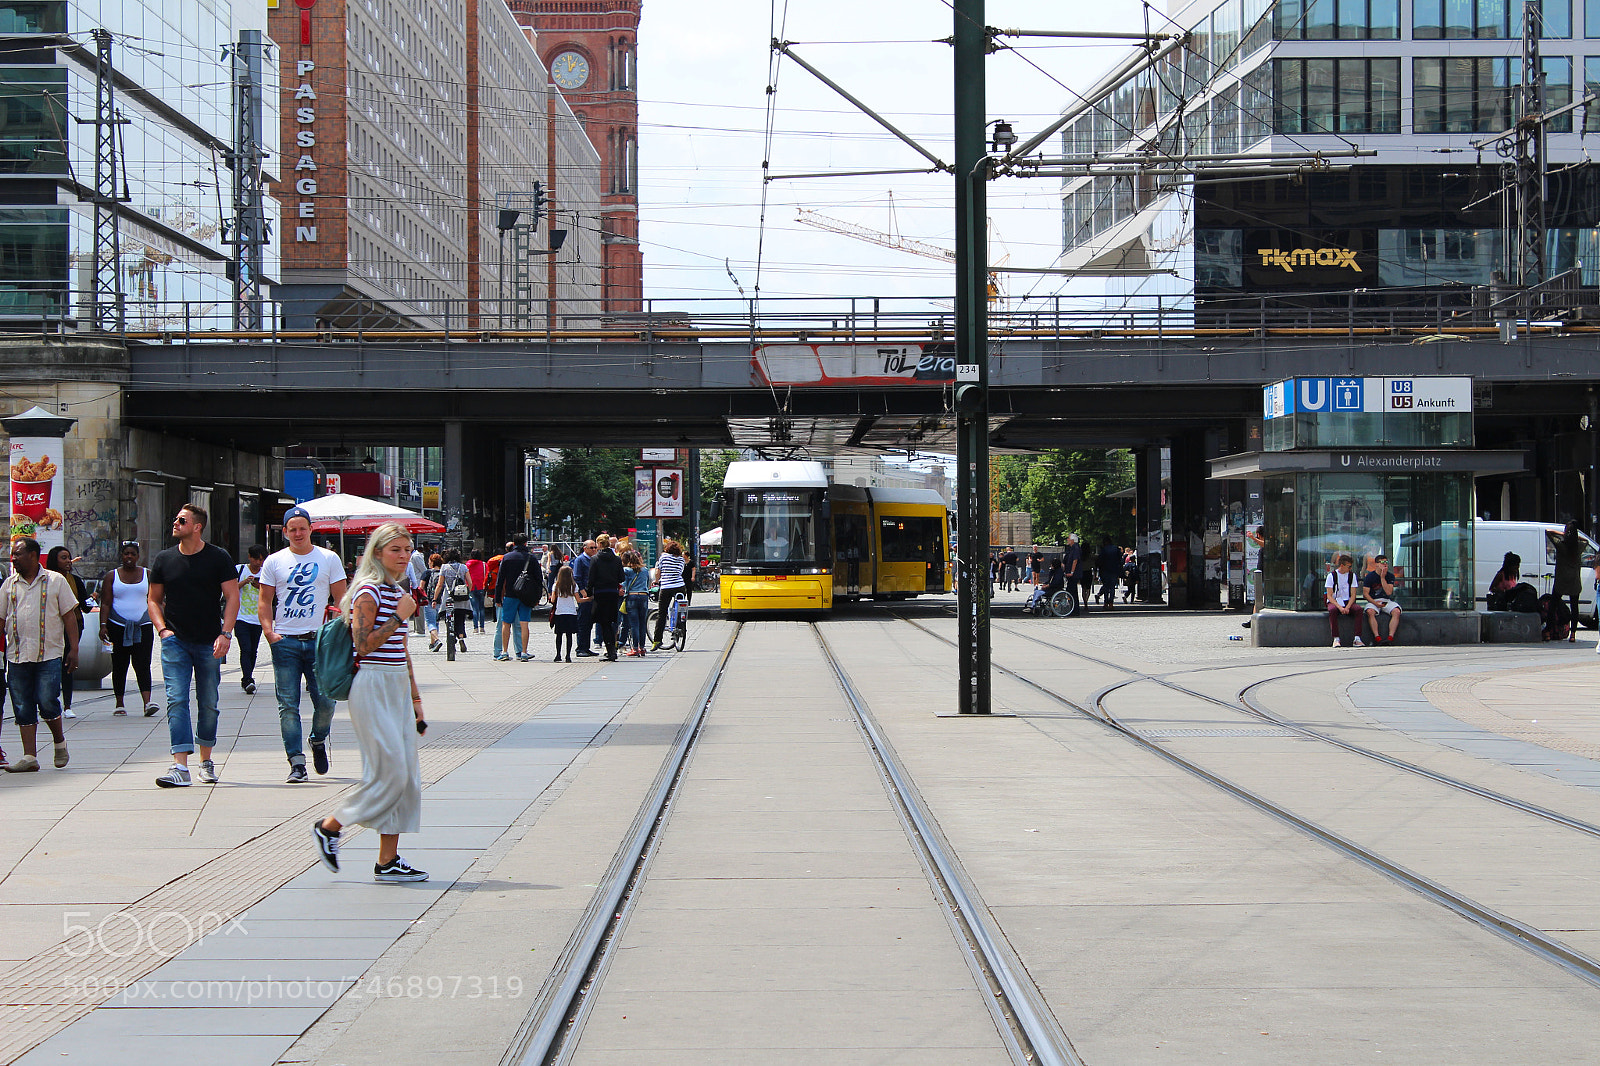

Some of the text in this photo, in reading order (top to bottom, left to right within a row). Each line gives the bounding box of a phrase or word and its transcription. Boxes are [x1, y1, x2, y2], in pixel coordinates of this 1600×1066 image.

[295, 60, 318, 242] PASSAGEN
[960, 365, 976, 373] 234
[1394, 382, 1411, 392] U8
[1302, 380, 1325, 410] U
[1394, 397, 1455, 408] U5 Ankunft
[1341, 455, 1442, 468] U Alexanderplatz
[26, 493, 44, 501] KFC
[286, 562, 319, 586] 19
[284, 586, 316, 606] 76
